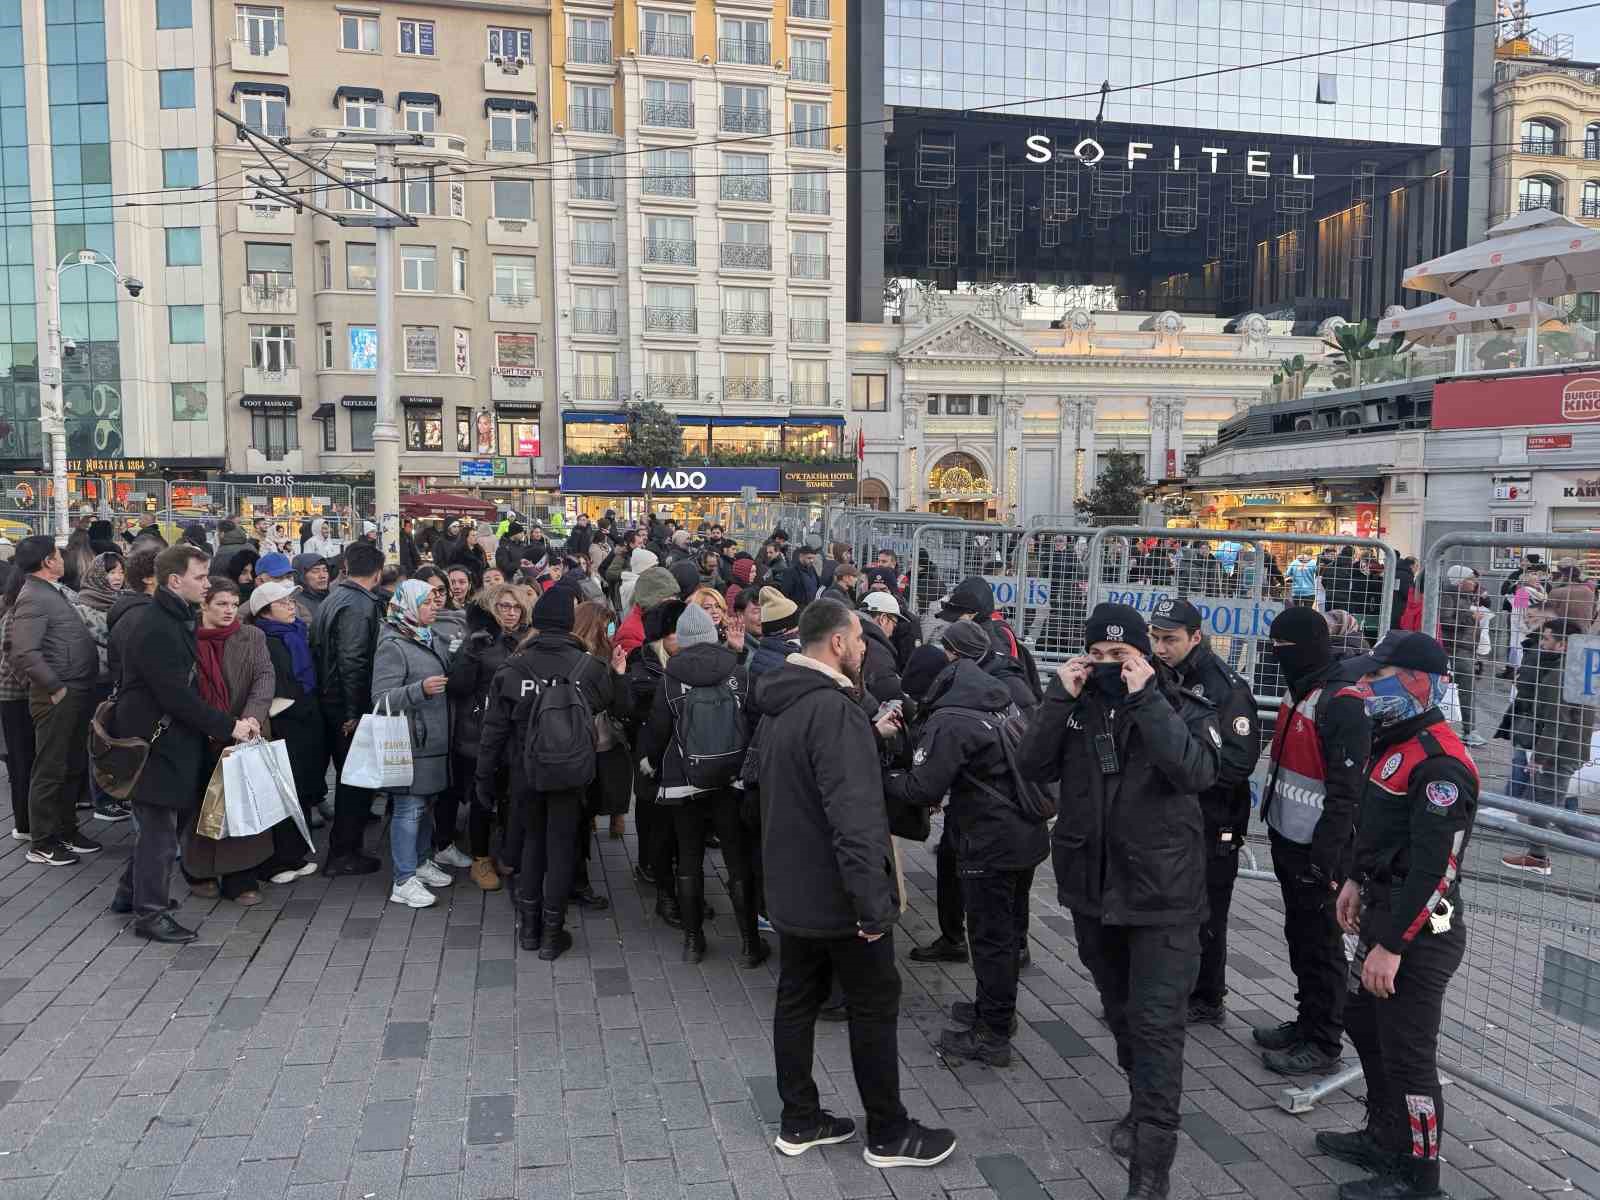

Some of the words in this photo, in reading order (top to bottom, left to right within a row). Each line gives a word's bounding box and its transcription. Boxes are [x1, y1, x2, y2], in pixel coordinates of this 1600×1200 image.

[1025, 135, 1315, 180] SOFITEL
[86, 458, 124, 472] MUSTAFA
[256, 475, 295, 486] LORIS
[641, 471, 706, 489] MADO
[830, 472, 855, 480] HOTEL
[991, 579, 1048, 605] OİS
[1197, 602, 1276, 636] POLİS
